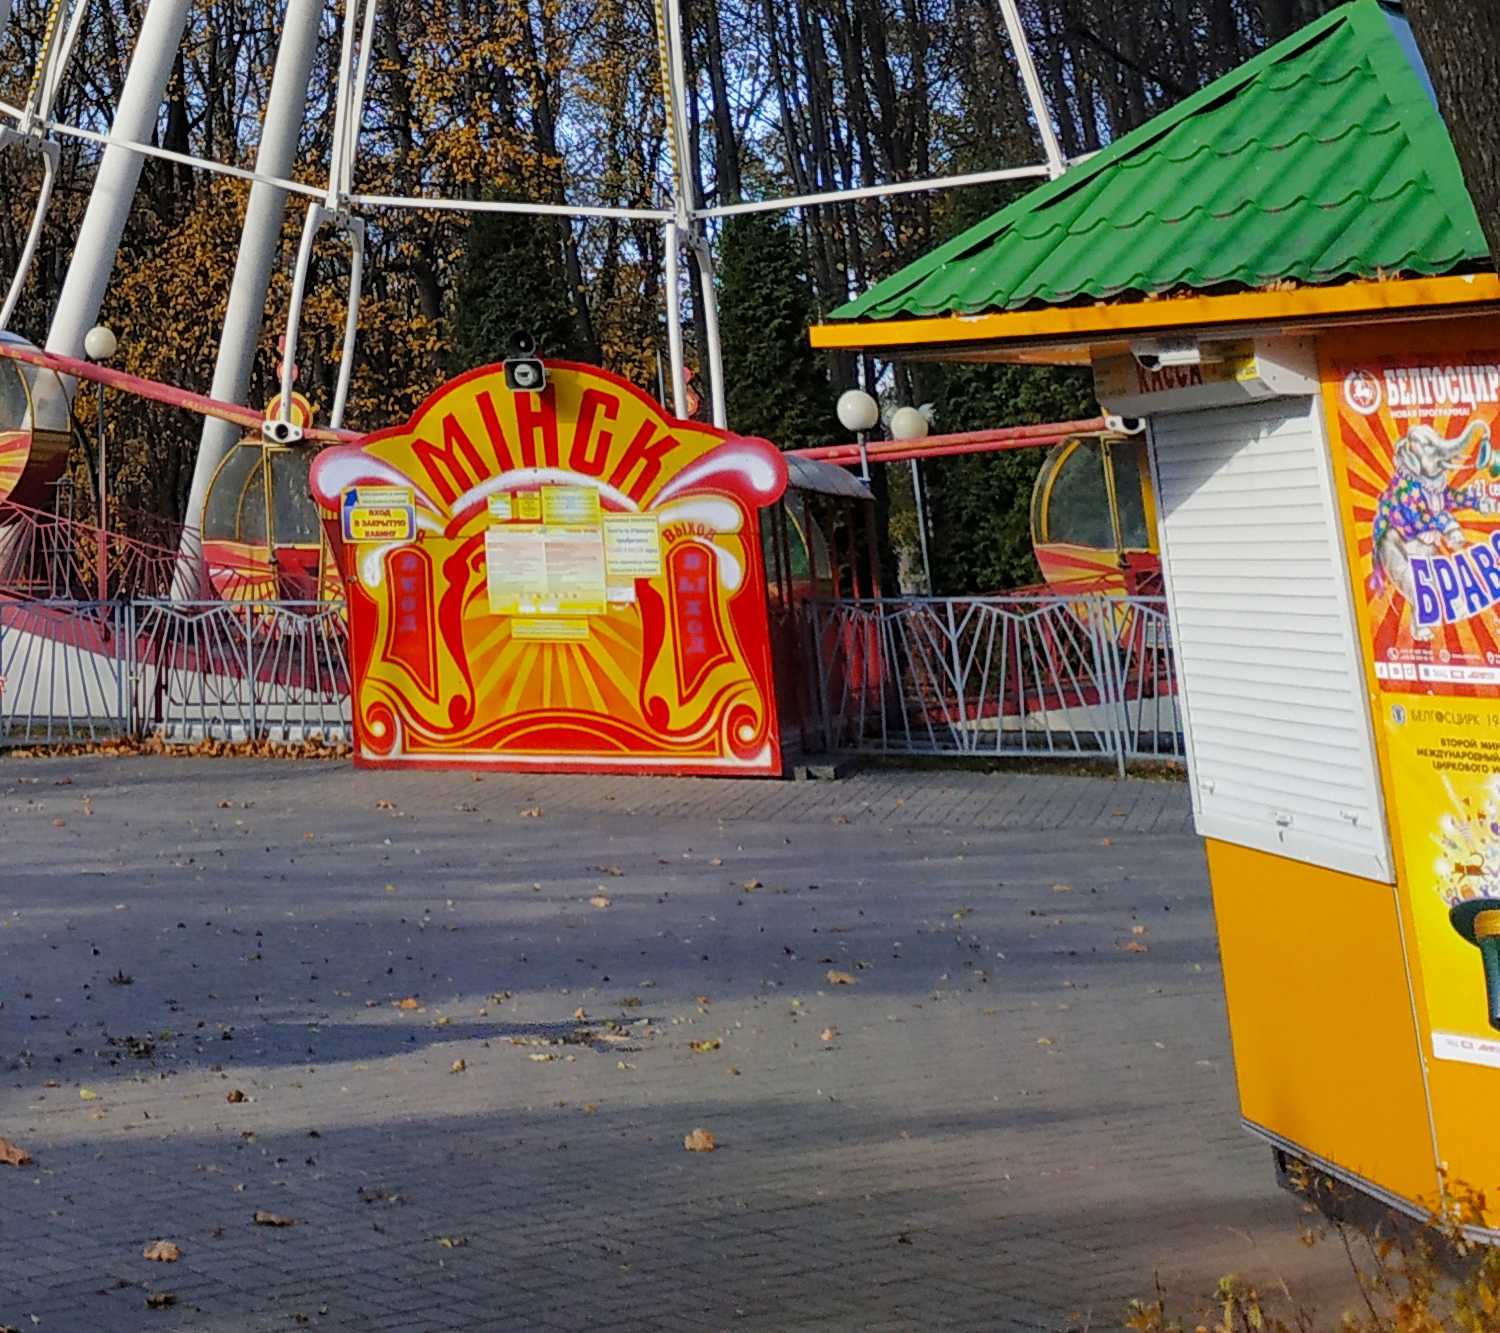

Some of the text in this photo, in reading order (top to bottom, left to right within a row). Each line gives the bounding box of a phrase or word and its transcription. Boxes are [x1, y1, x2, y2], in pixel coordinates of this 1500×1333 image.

[1384, 365, 1500, 411] БЕЛГОСЦИР
[662, 522, 716, 544] ВЫХОД
[1440, 738, 1477, 749] ВТОРОЙ
[1432, 760, 1489, 774] ЦИРКОВОГО
